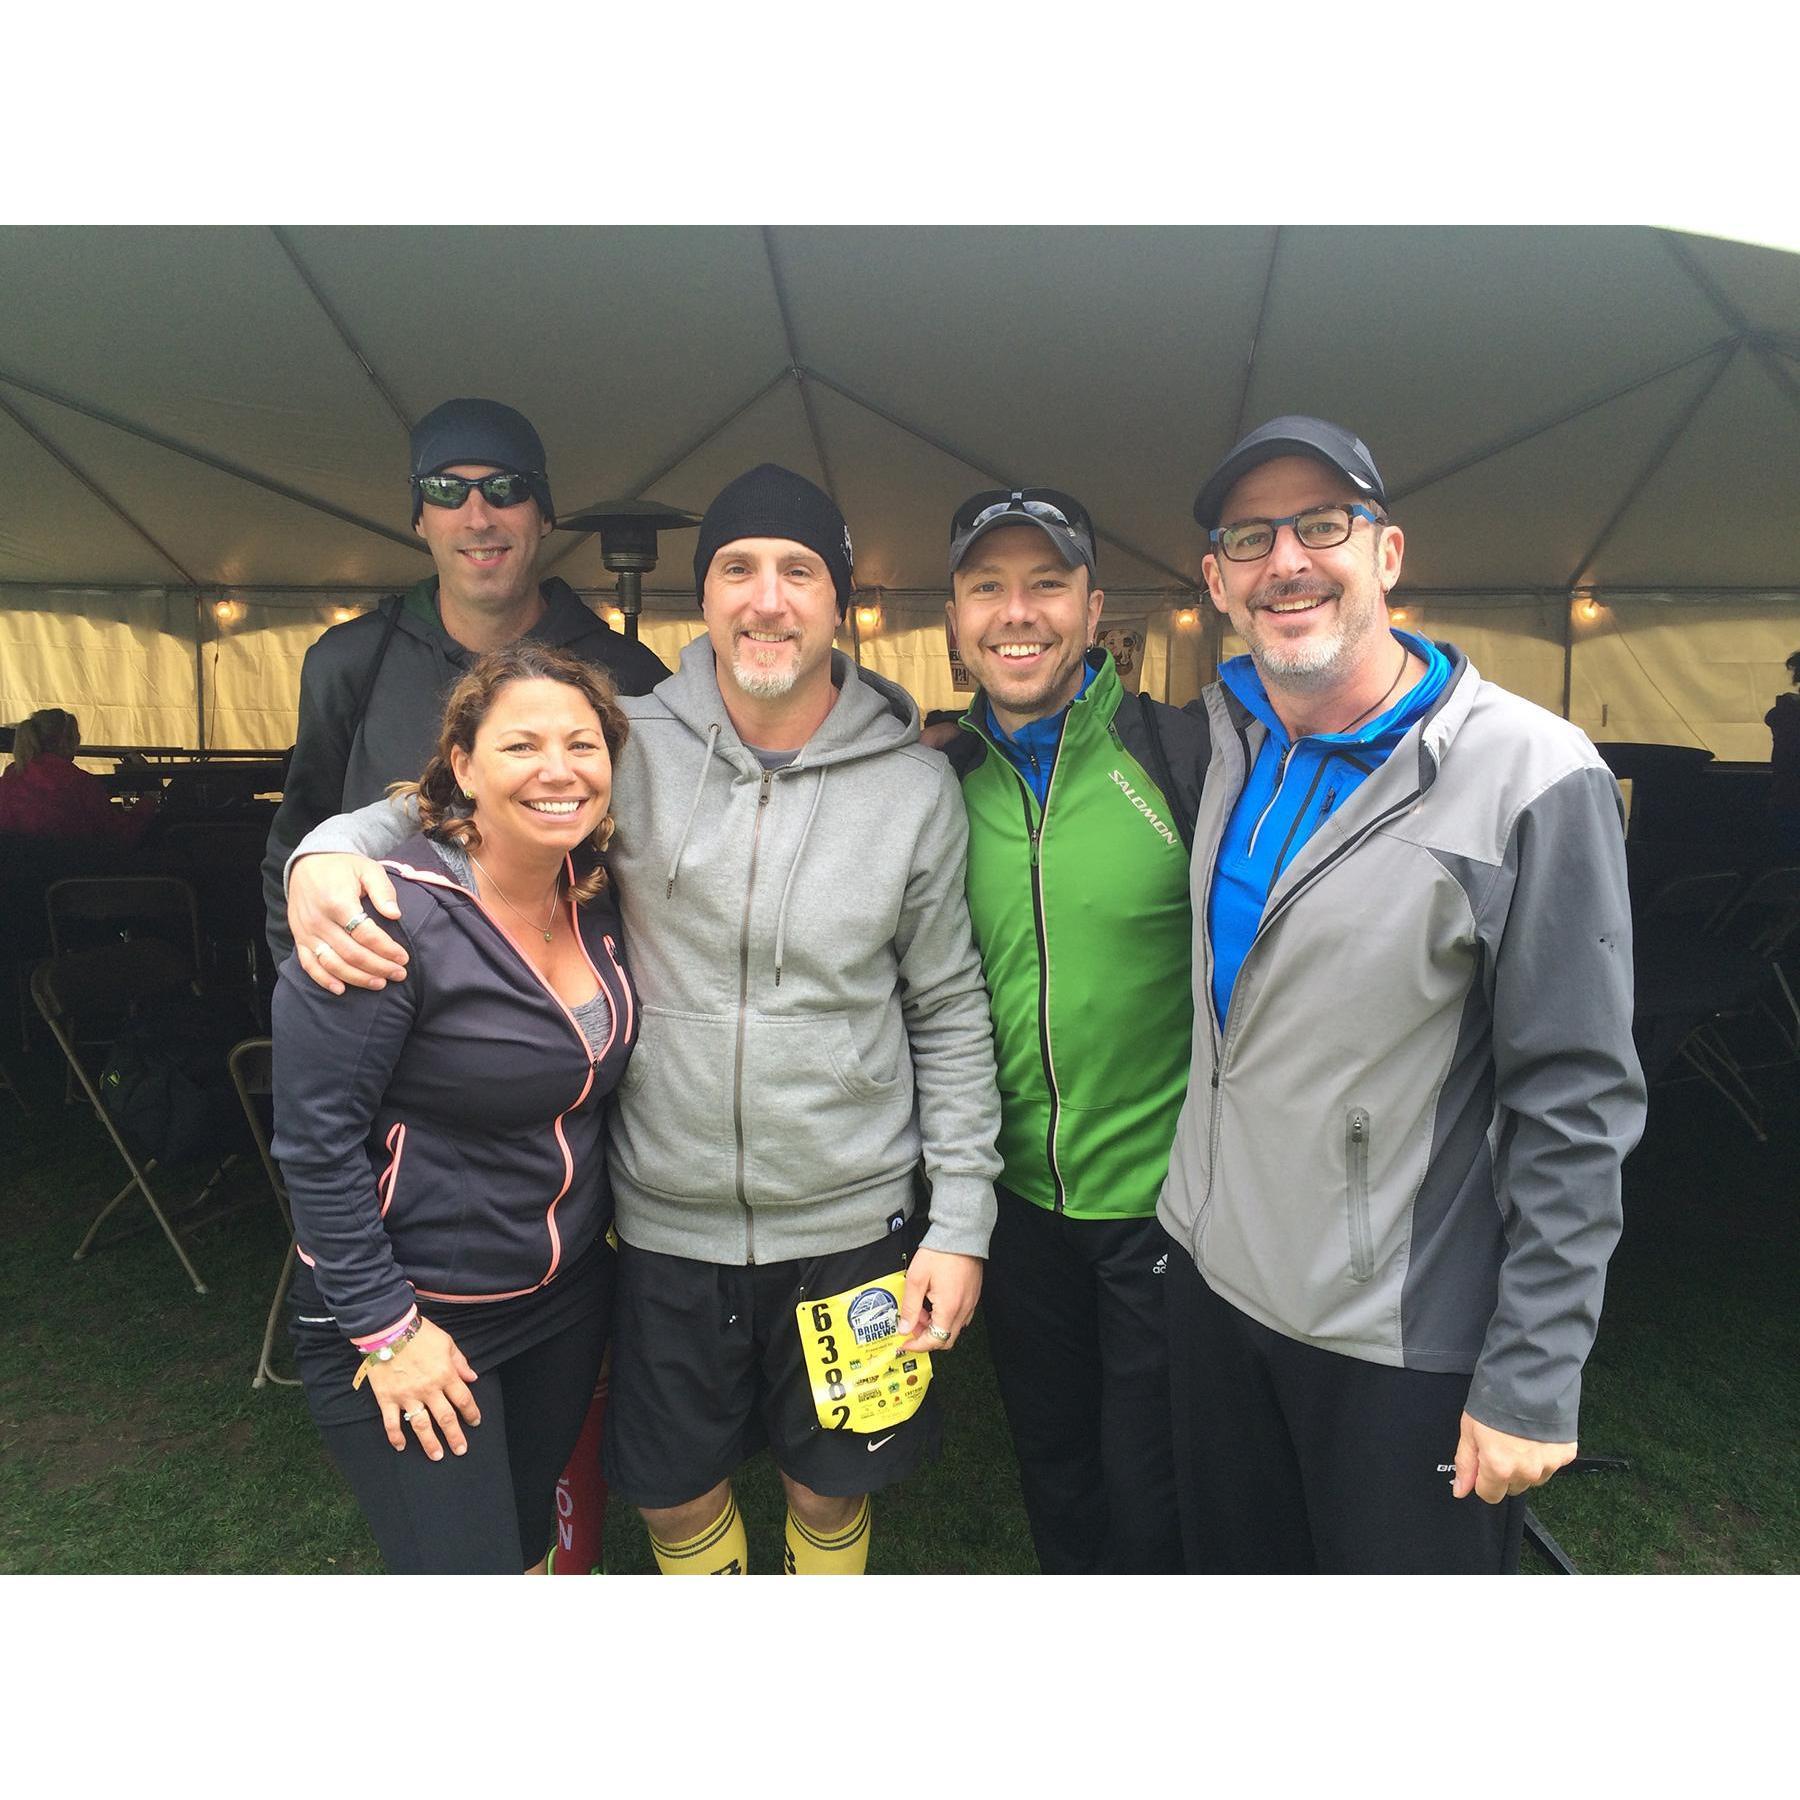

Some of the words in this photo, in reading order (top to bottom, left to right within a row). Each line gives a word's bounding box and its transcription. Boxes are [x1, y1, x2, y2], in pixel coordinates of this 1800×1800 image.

[1108, 769, 1177, 845] SALOMON
[857, 1319, 890, 1336] BRIDGE
[865, 1325, 897, 1343] BREWS
